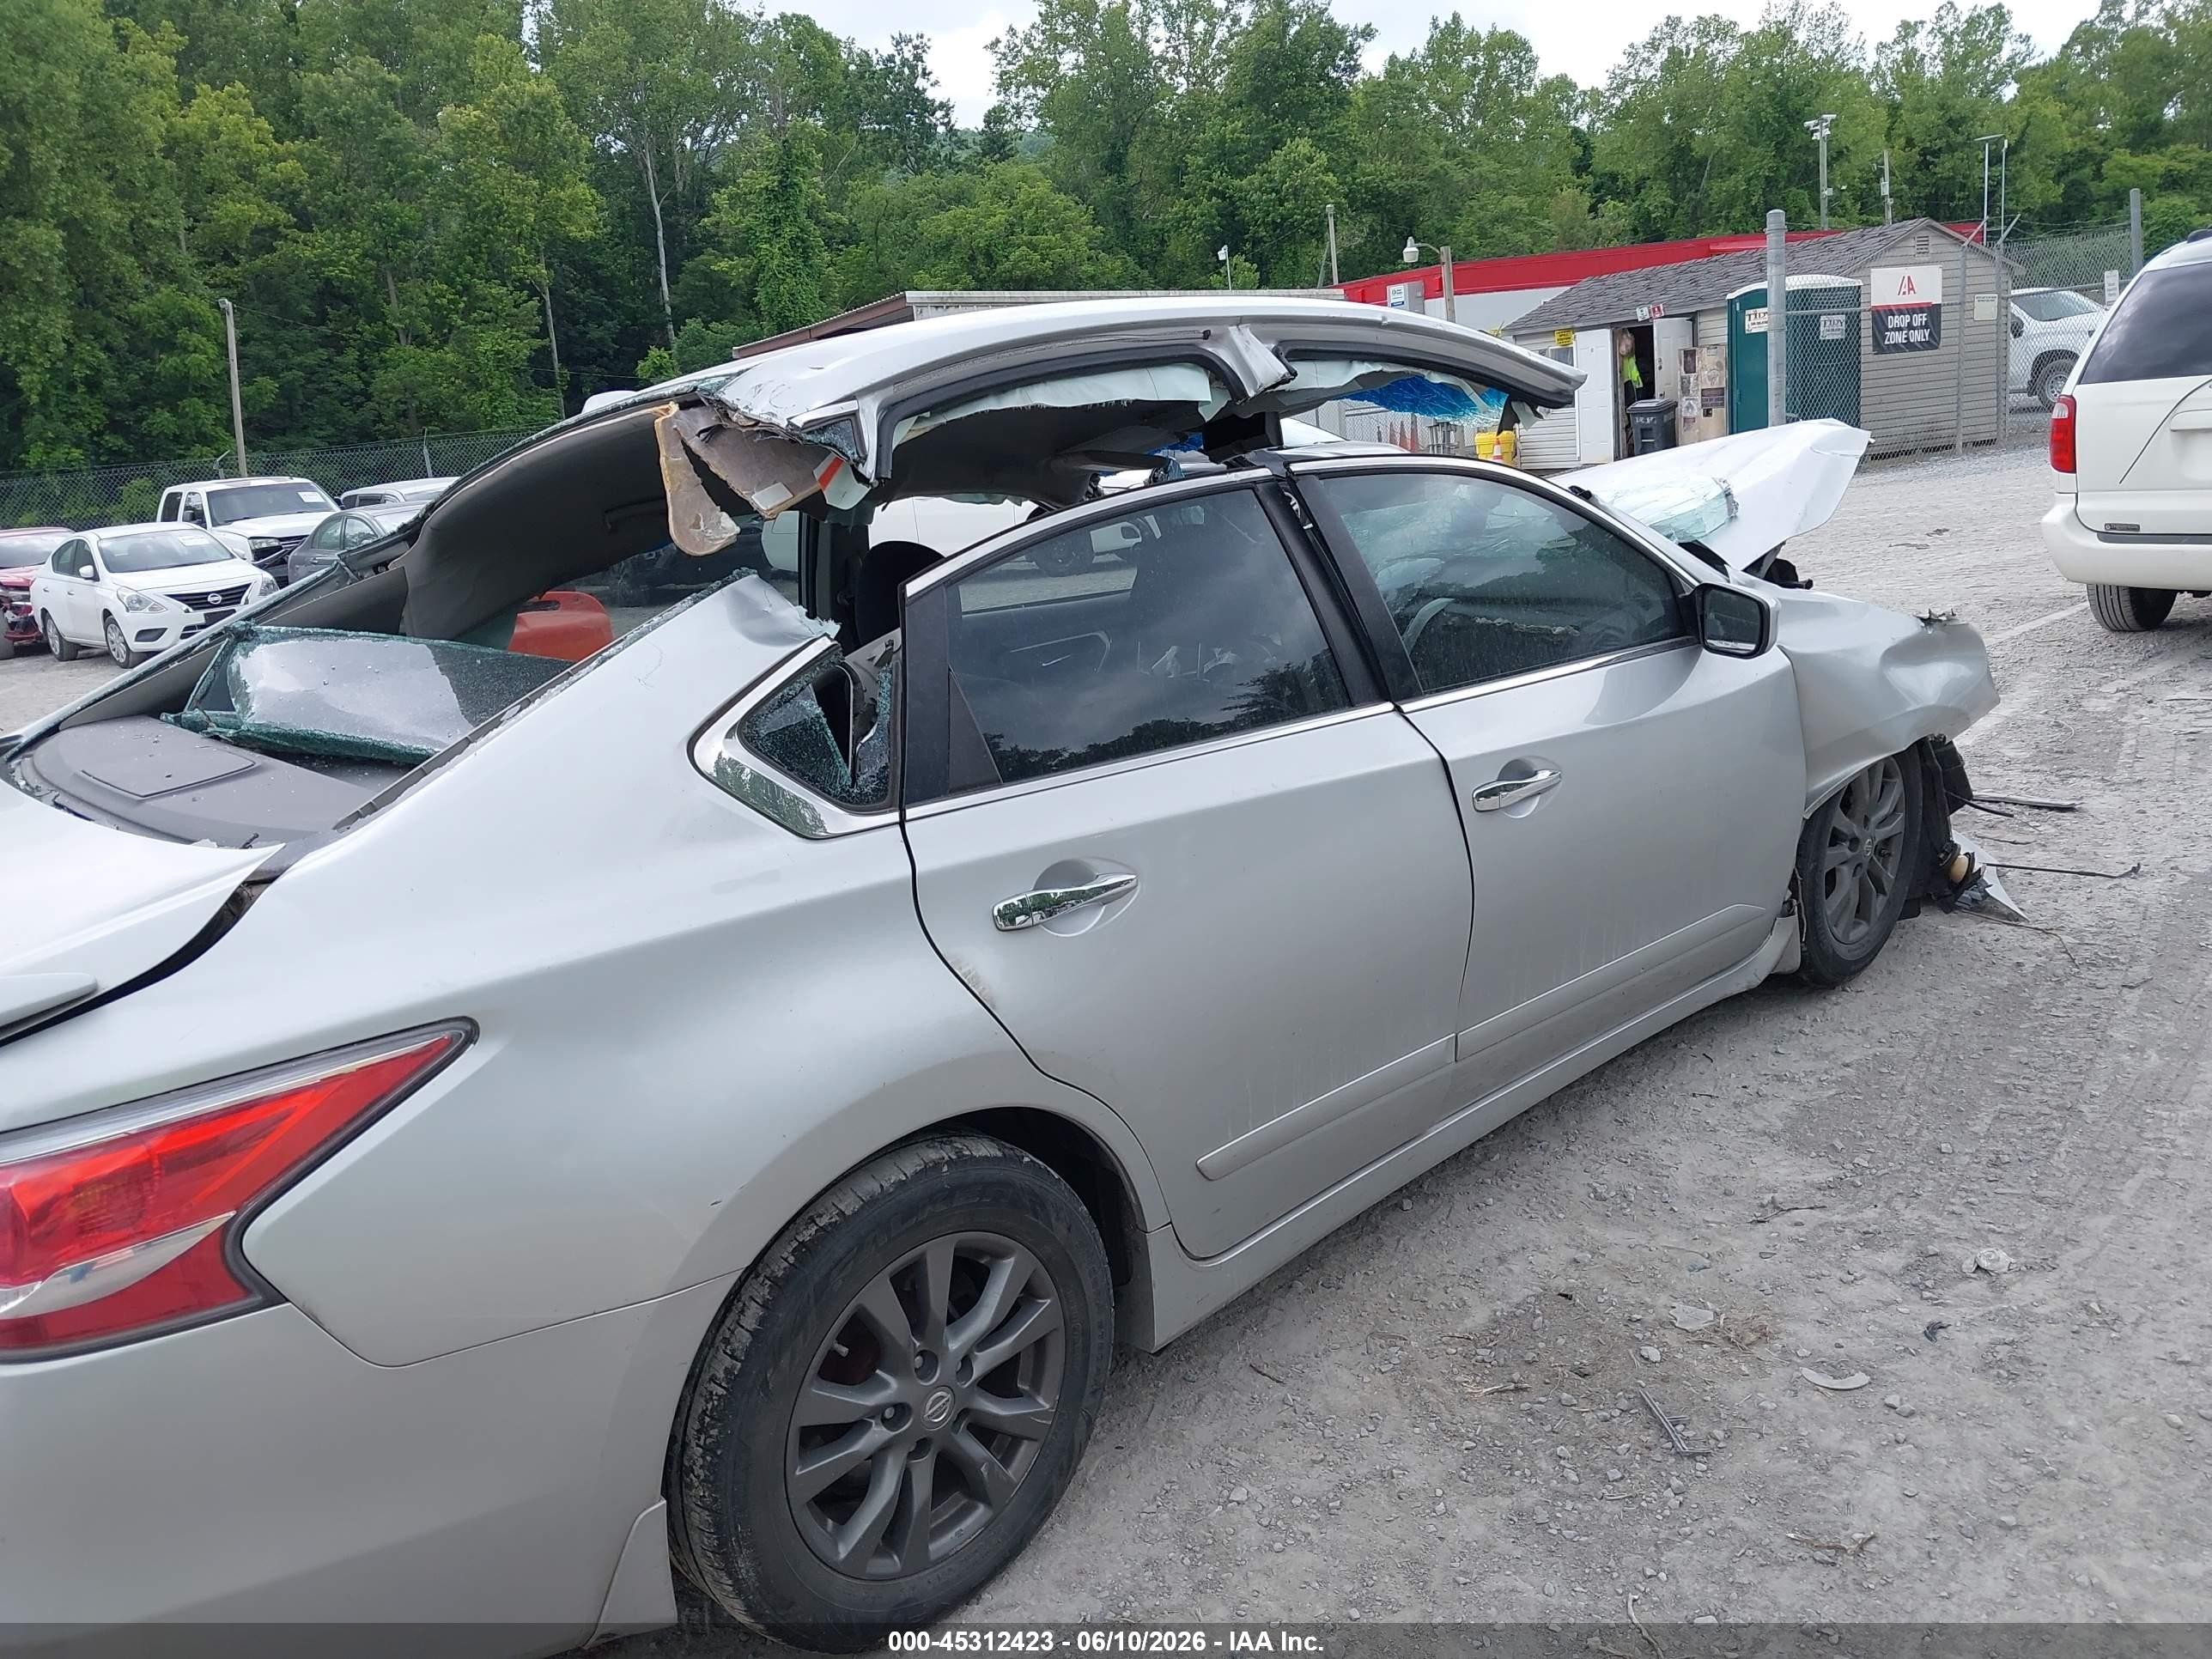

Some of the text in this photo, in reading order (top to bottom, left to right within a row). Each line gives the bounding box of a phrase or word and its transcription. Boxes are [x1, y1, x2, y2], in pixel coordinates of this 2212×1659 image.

[1887, 313, 1928, 328] DROP OFF
[1884, 329, 1931, 344] ZONE ONLY
